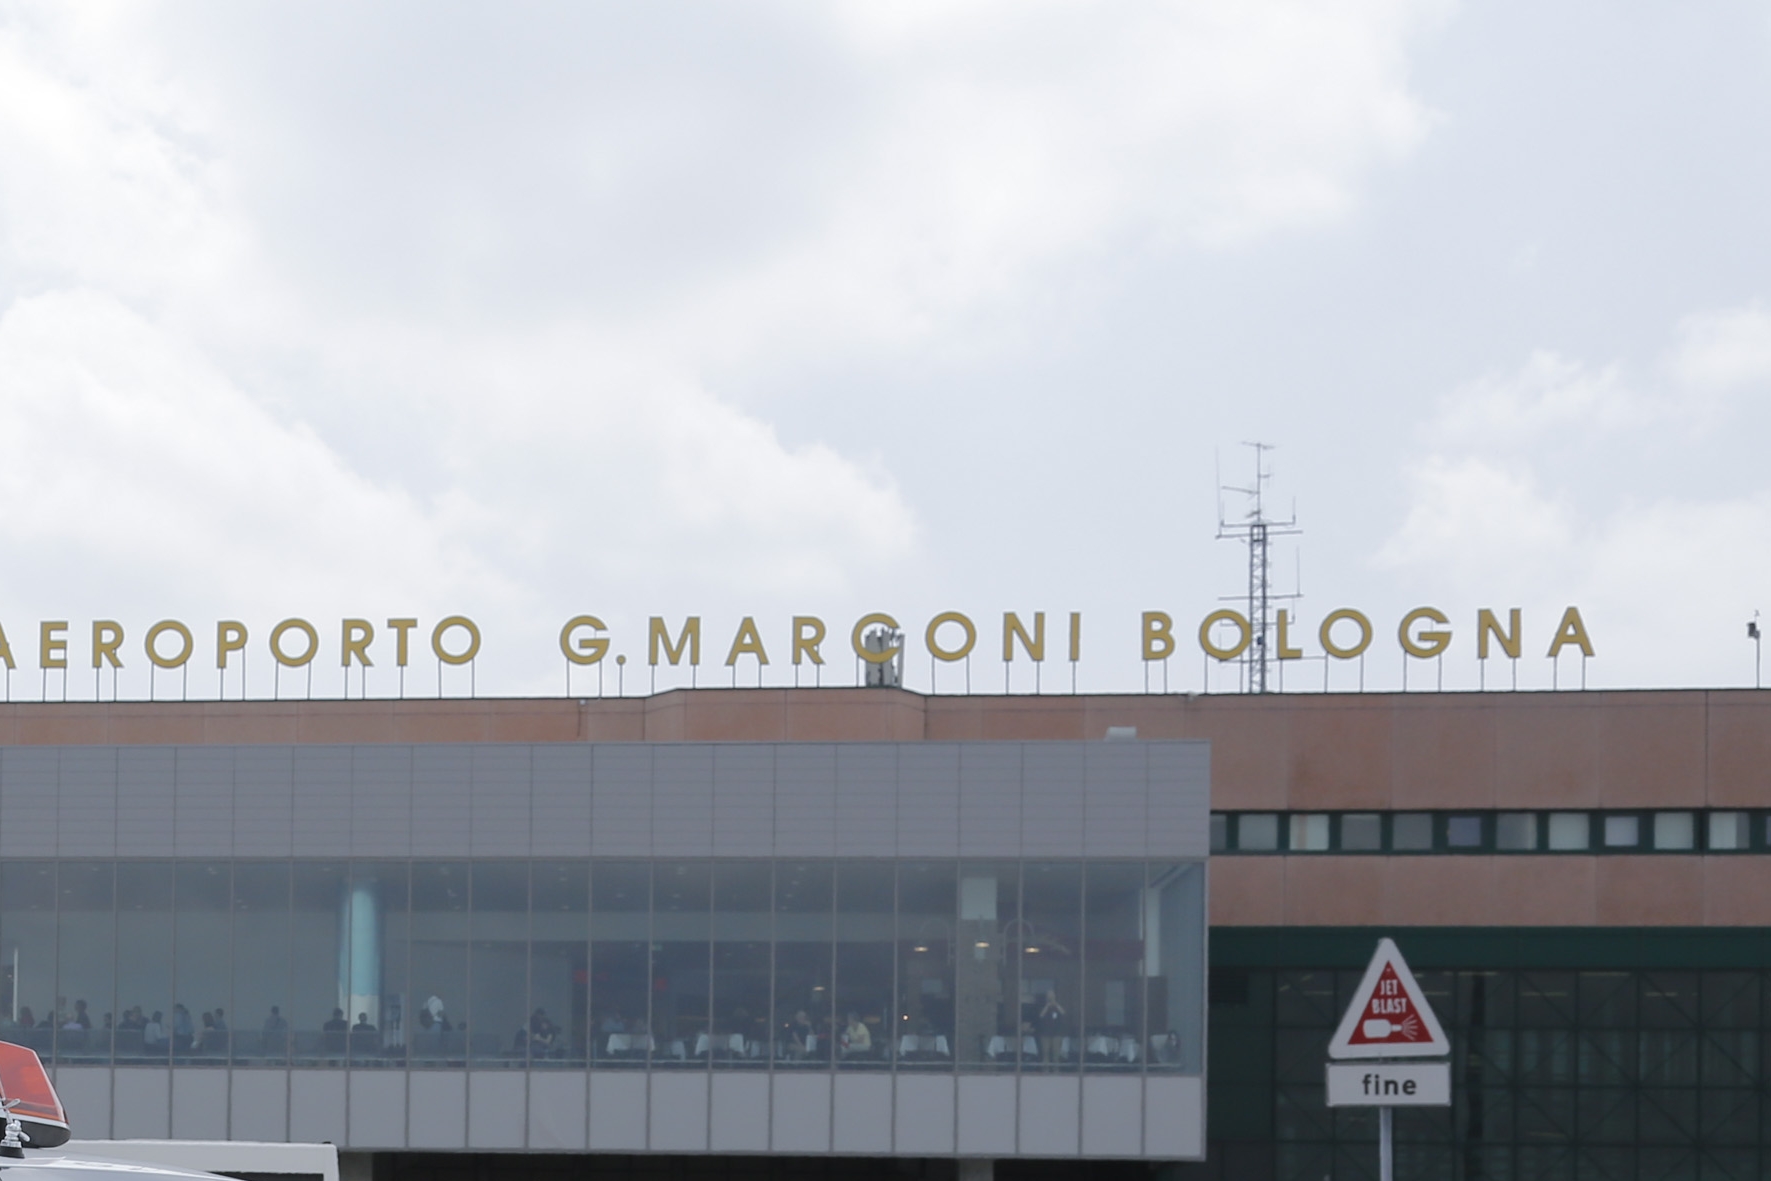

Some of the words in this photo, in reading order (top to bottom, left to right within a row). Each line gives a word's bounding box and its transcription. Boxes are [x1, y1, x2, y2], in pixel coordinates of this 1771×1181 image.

[1141, 606, 1595, 662] BOLOGNA
[1380, 979, 1398, 996] JET
[1371, 998, 1407, 1014] BLAST
[1362, 1073, 1417, 1096] fine
